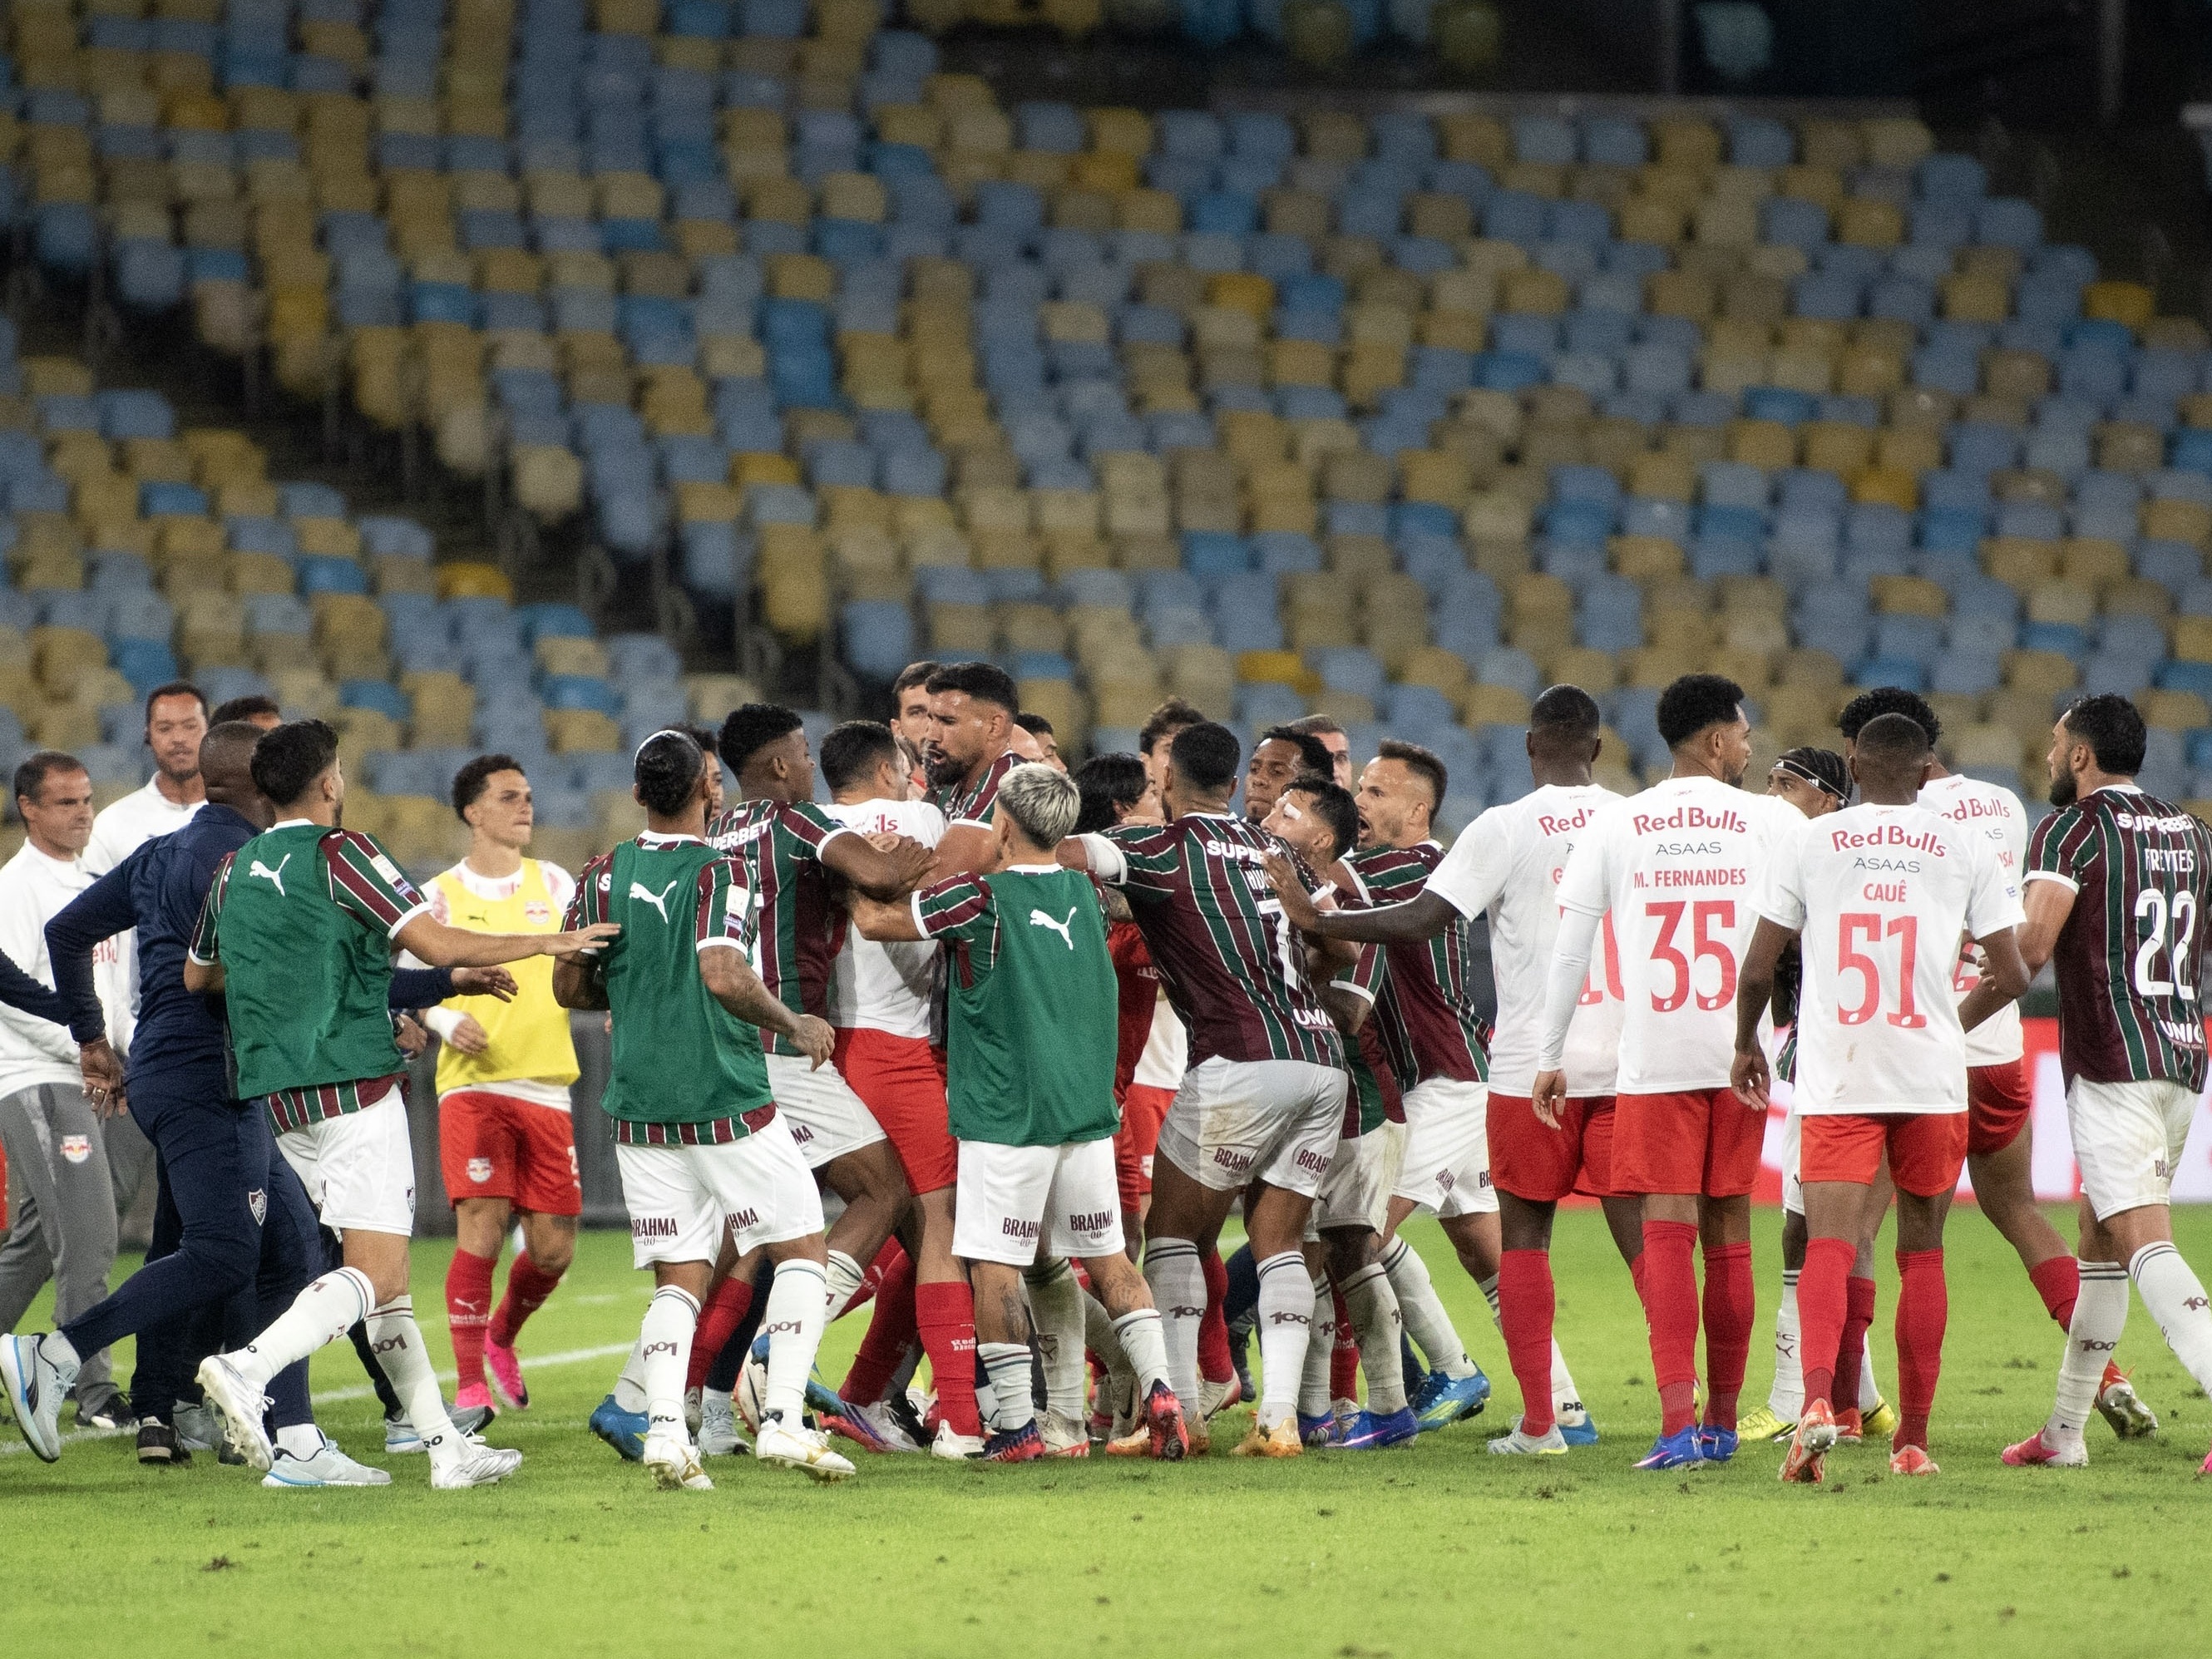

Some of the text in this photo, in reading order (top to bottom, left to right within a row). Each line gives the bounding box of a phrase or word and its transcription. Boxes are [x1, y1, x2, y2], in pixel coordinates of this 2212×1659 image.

[1656, 842, 1722, 856] ASAAS
[2145, 848, 2195, 872] FREYTES
[1854, 857, 1920, 873] ASAAS
[1634, 868, 1746, 889] M. FERNANDES
[1864, 879, 1907, 902] CAUÊ
[1257, 898, 1298, 991] 7
[2135, 888, 2195, 1000] 22
[1646, 901, 1736, 1012] 35
[1838, 913, 1928, 1029] 51
[1213, 1148, 1257, 1172] BRAHM
[1296, 1148, 1331, 1173] BRAH
[1002, 1217, 1041, 1238] BRAHM
[1168, 1305, 1205, 1320] 100
[768, 1320, 802, 1335] 001
[2080, 1338, 2116, 1351] 100
[1563, 1401, 1584, 1412] PR
